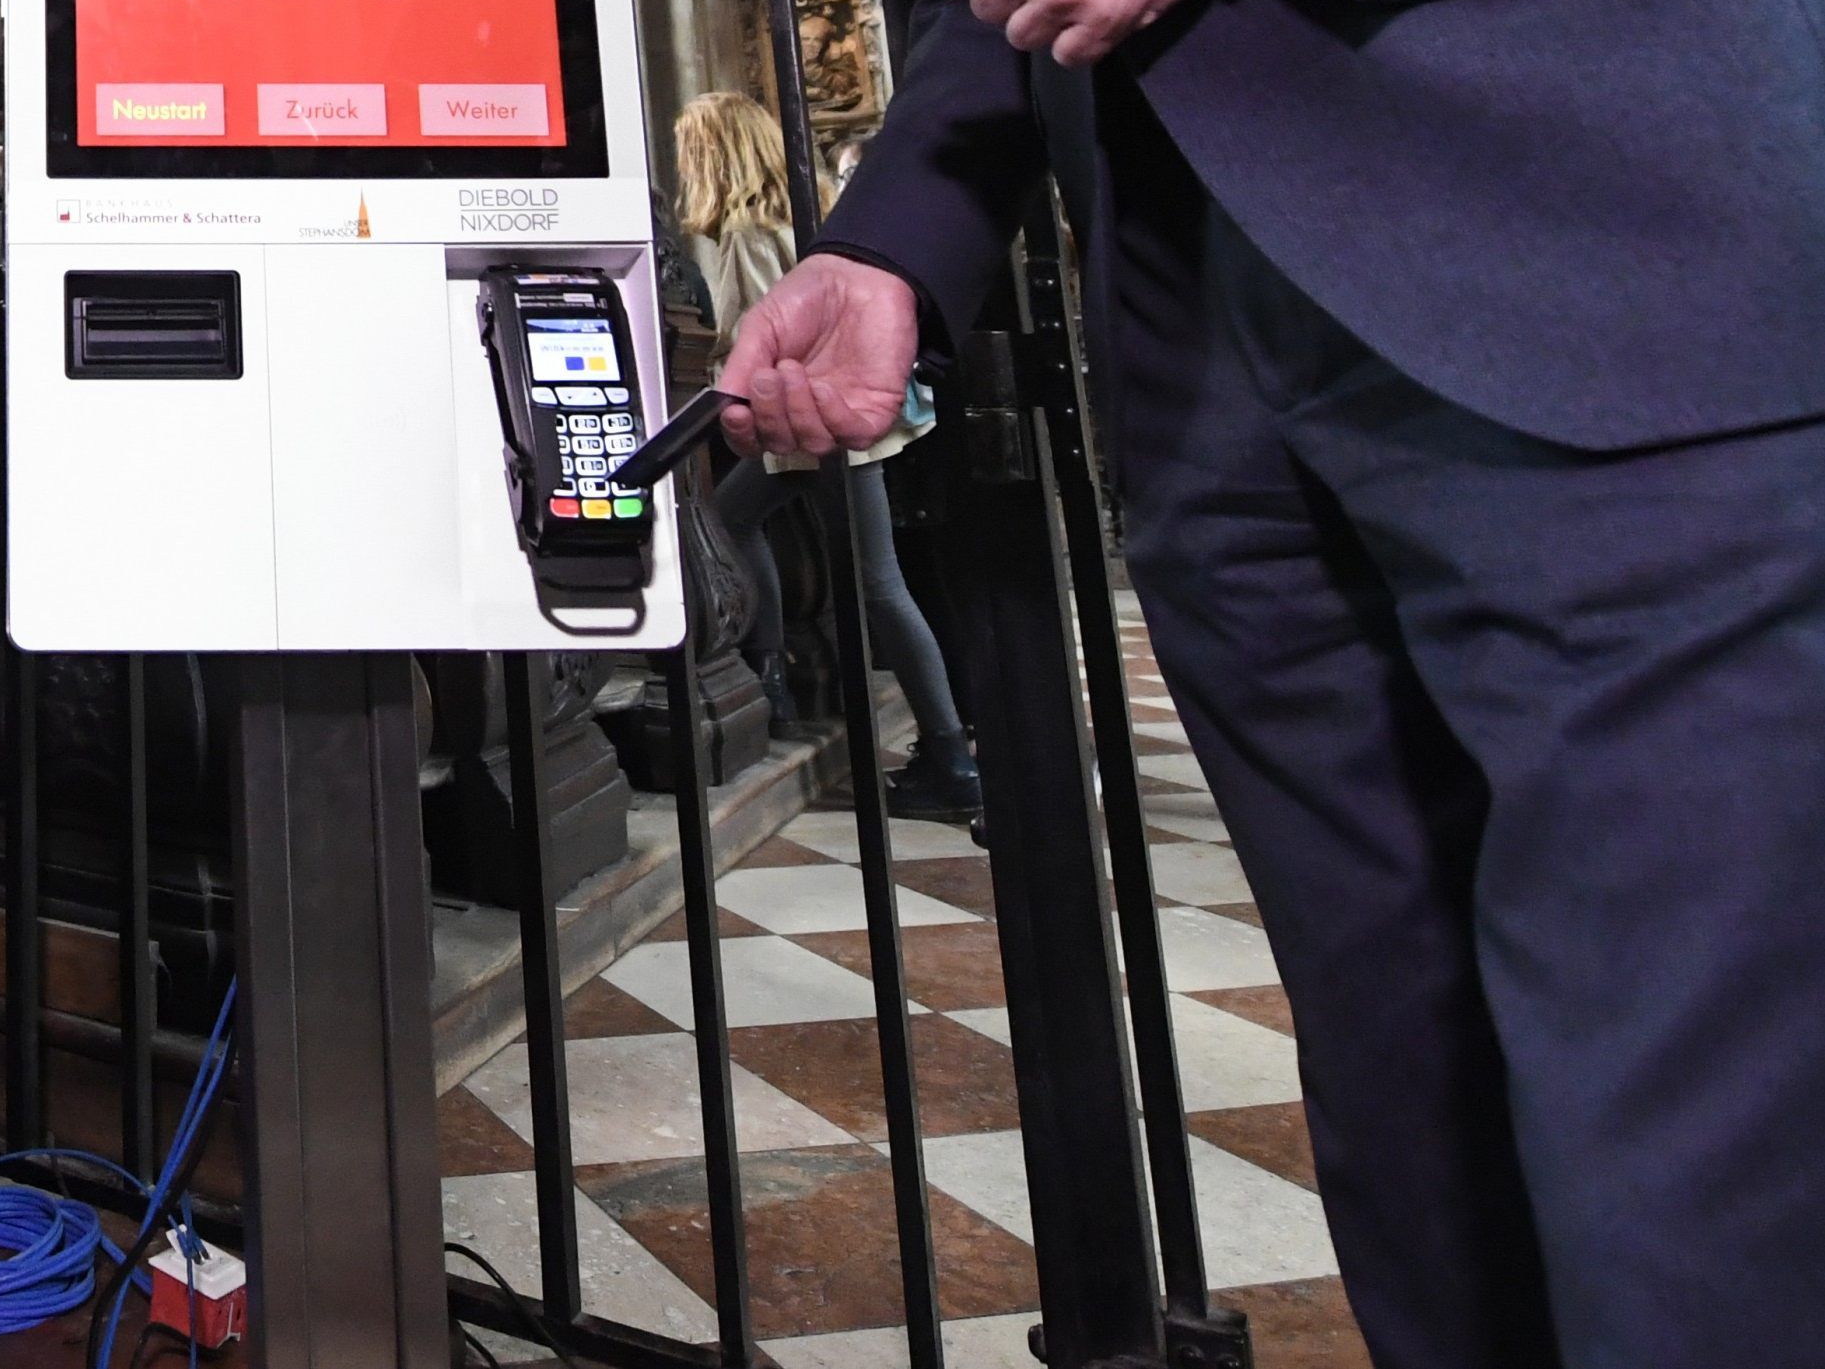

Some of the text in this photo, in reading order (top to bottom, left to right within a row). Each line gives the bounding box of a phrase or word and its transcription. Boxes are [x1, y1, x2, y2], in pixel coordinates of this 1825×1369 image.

[111, 99, 208, 122] Neustart
[285, 98, 359, 121] Zurück
[446, 99, 518, 120] Weiter
[458, 188, 559, 207] DIEBOLD
[85, 211, 262, 225] Schelhammer & Schattera
[460, 213, 560, 232] NIXDORF
